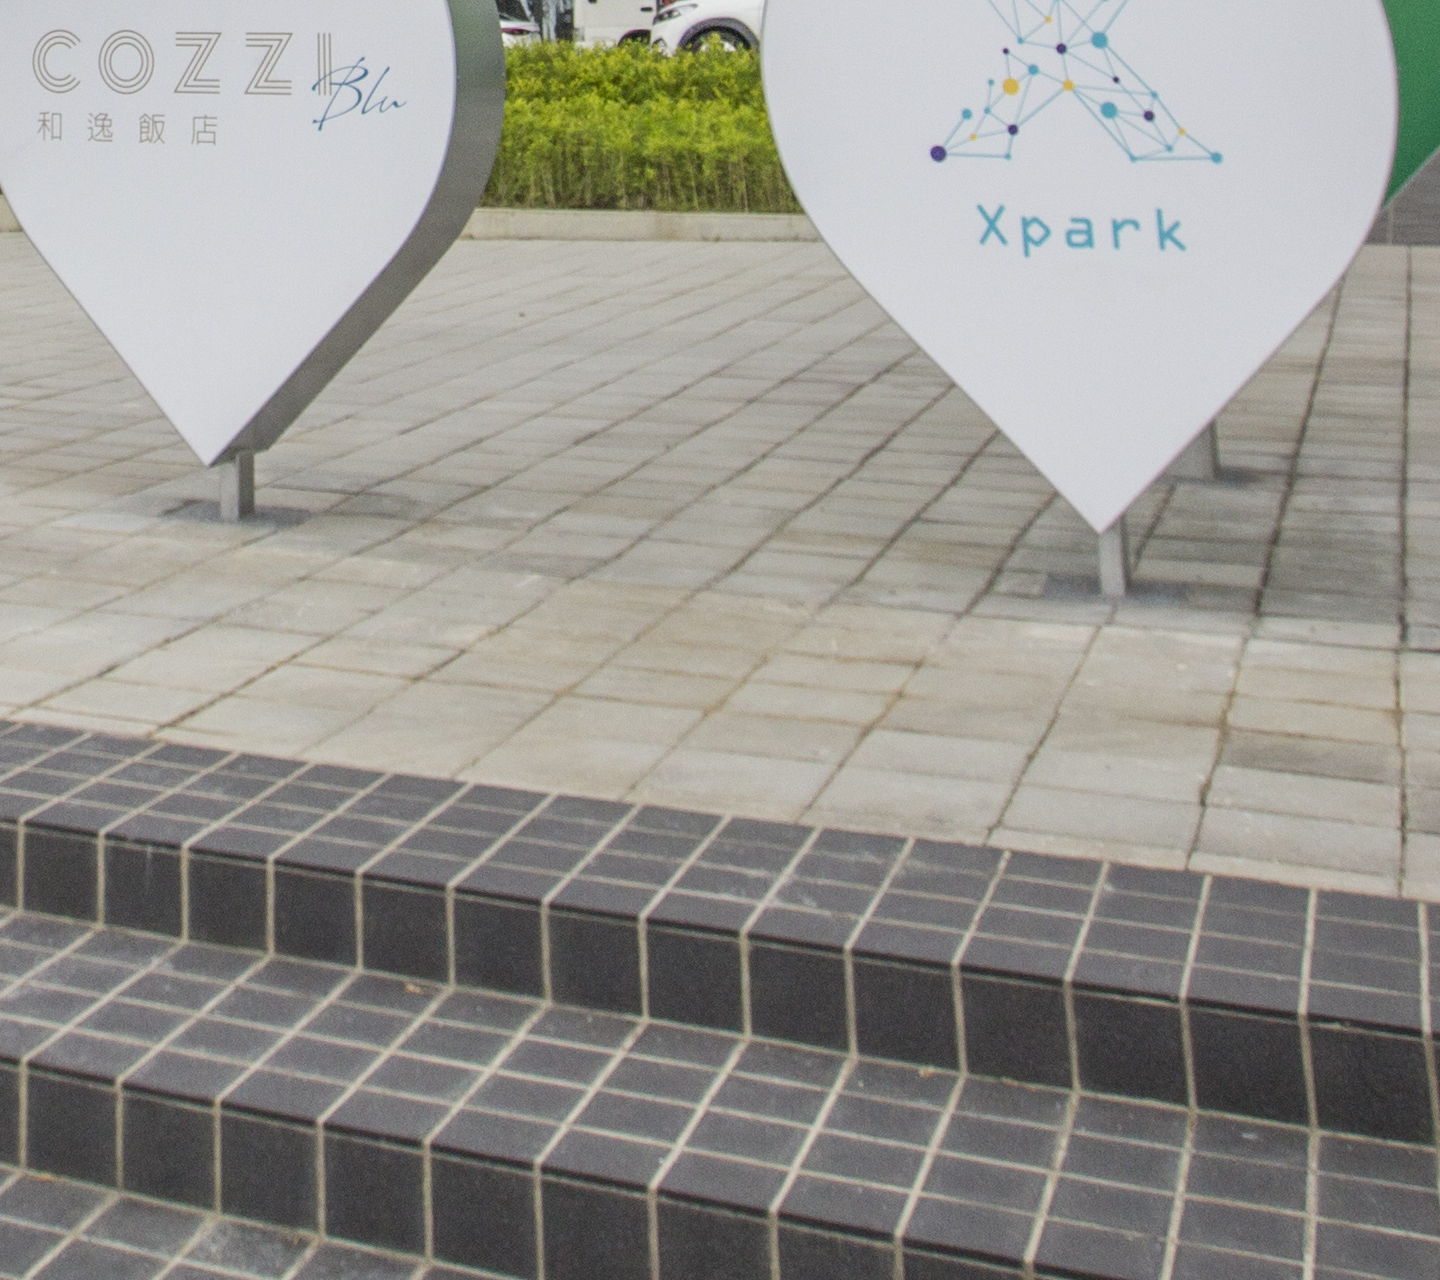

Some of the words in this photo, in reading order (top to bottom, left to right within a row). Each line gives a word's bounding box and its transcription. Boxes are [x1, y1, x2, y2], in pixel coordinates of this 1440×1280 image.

[32, 29, 332, 96] COZZI
[311, 57, 408, 132] Blu
[36, 110, 219, 146] 和逸飯店
[975, 203, 1188, 259] Xpark
